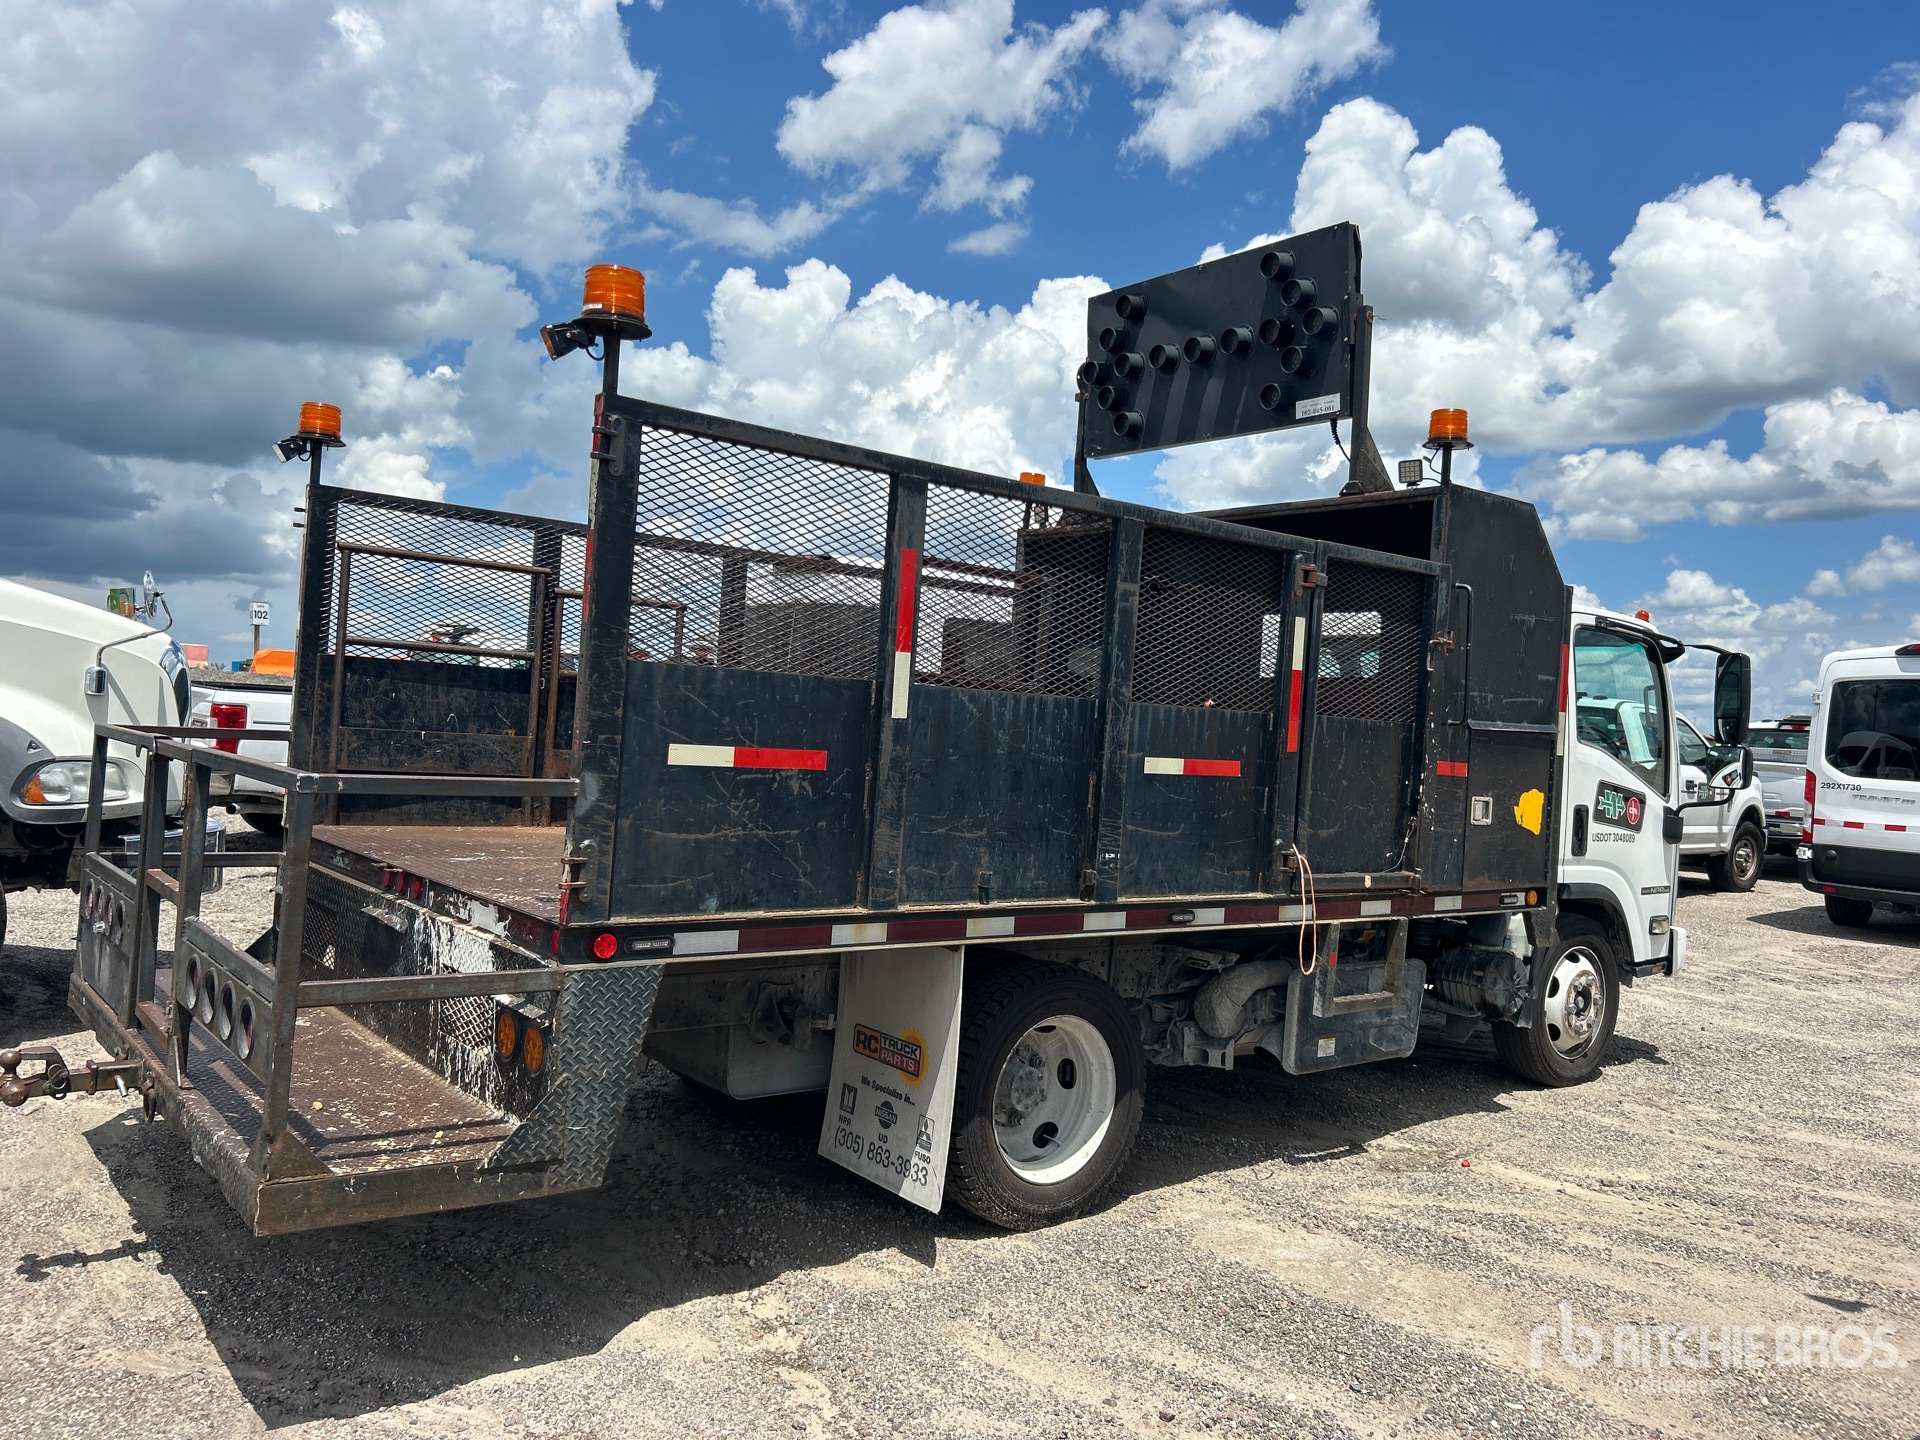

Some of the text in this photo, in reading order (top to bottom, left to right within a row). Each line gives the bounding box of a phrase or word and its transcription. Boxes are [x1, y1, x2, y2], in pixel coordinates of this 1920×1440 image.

[254, 609, 268, 620] 102
[1820, 782, 1862, 791] 292X1730
[1592, 832, 1612, 842] USDOT
[855, 1029, 919, 1059] RC TRUCK
[880, 1050, 916, 1072] PARTS
[861, 1076, 871, 1087] We
[871, 1079, 903, 1101] Specialize
[838, 1114, 852, 1126] NPR
[875, 1106, 897, 1125] NISSAN
[878, 1132, 888, 1144] UD
[834, 1125, 929, 1187] (305) 863-3933
[914, 1150, 931, 1165] FUSO
